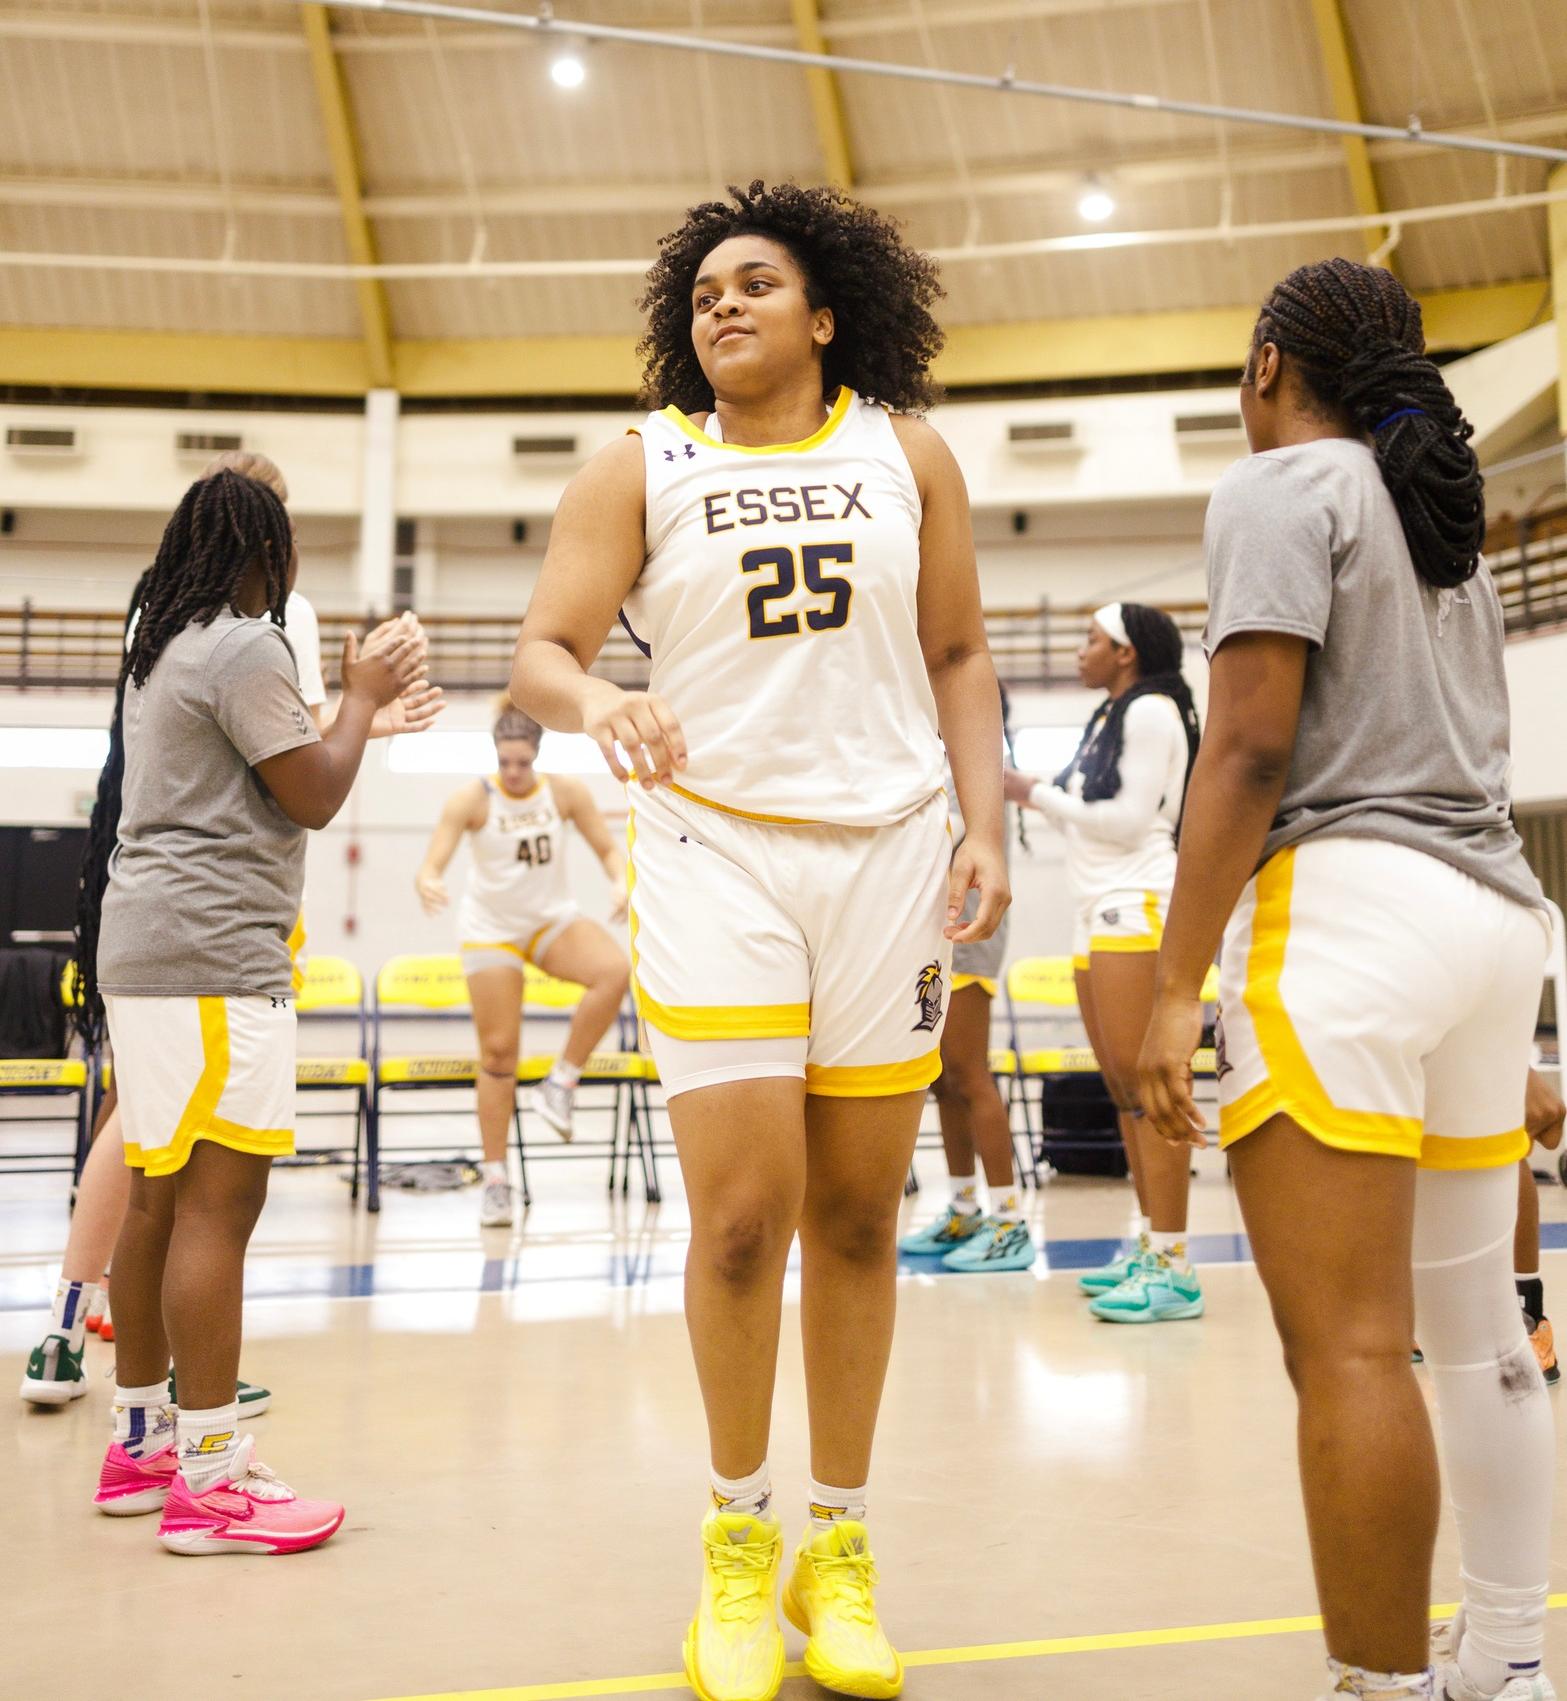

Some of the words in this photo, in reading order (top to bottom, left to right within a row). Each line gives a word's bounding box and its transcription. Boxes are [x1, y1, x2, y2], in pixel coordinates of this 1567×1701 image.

[704, 482, 873, 535] ESSEX
[739, 540, 855, 641] 25
[517, 834, 552, 869] 40
